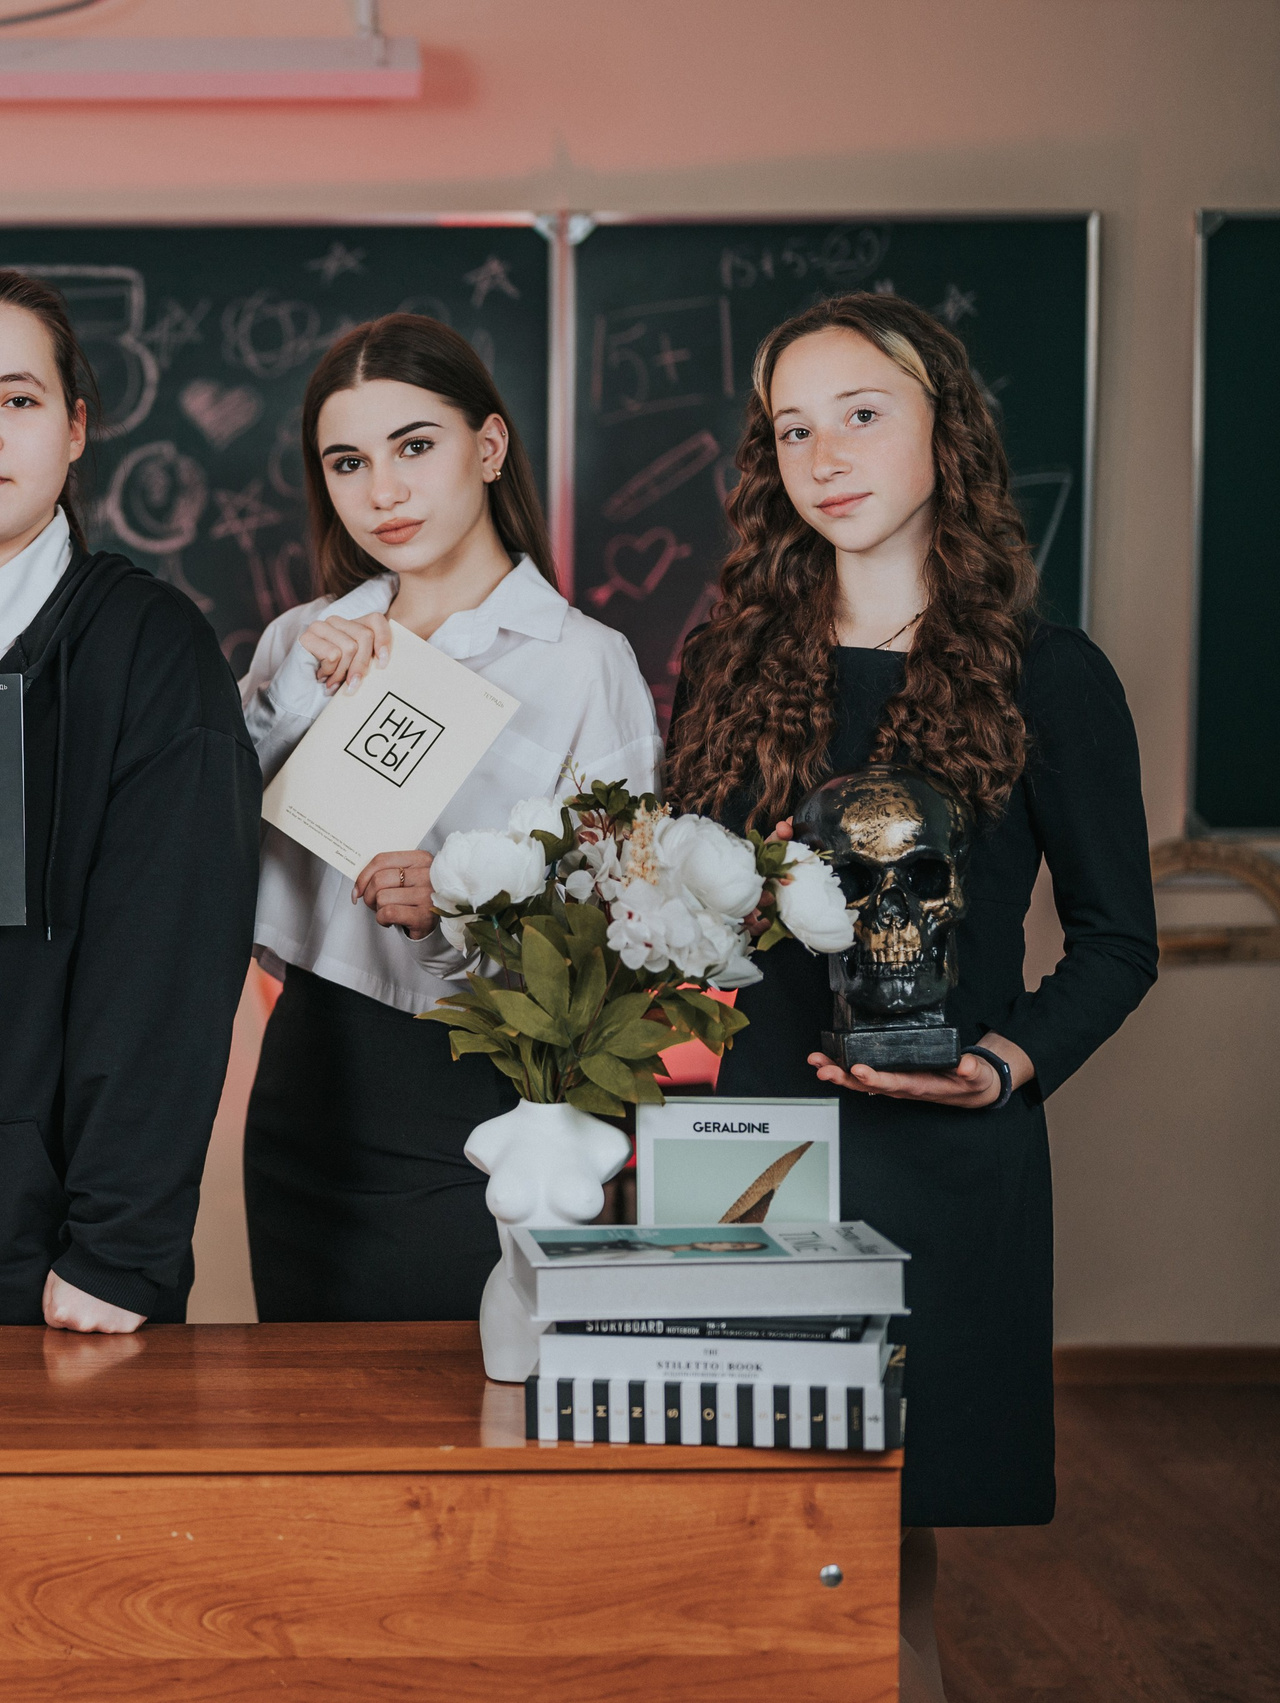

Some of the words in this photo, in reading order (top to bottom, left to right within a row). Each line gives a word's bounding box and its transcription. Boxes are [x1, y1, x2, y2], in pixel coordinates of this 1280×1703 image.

[379, 709, 427, 749] НИ
[364, 733, 410, 772] СЫ
[693, 1121, 770, 1134] GERALDINE
[586, 1320, 664, 1334] STORYBOARD
[666, 1326, 700, 1335] NOTEBOOK
[657, 1361, 719, 1371] STILETTO
[727, 1362, 762, 1371] BOOK
